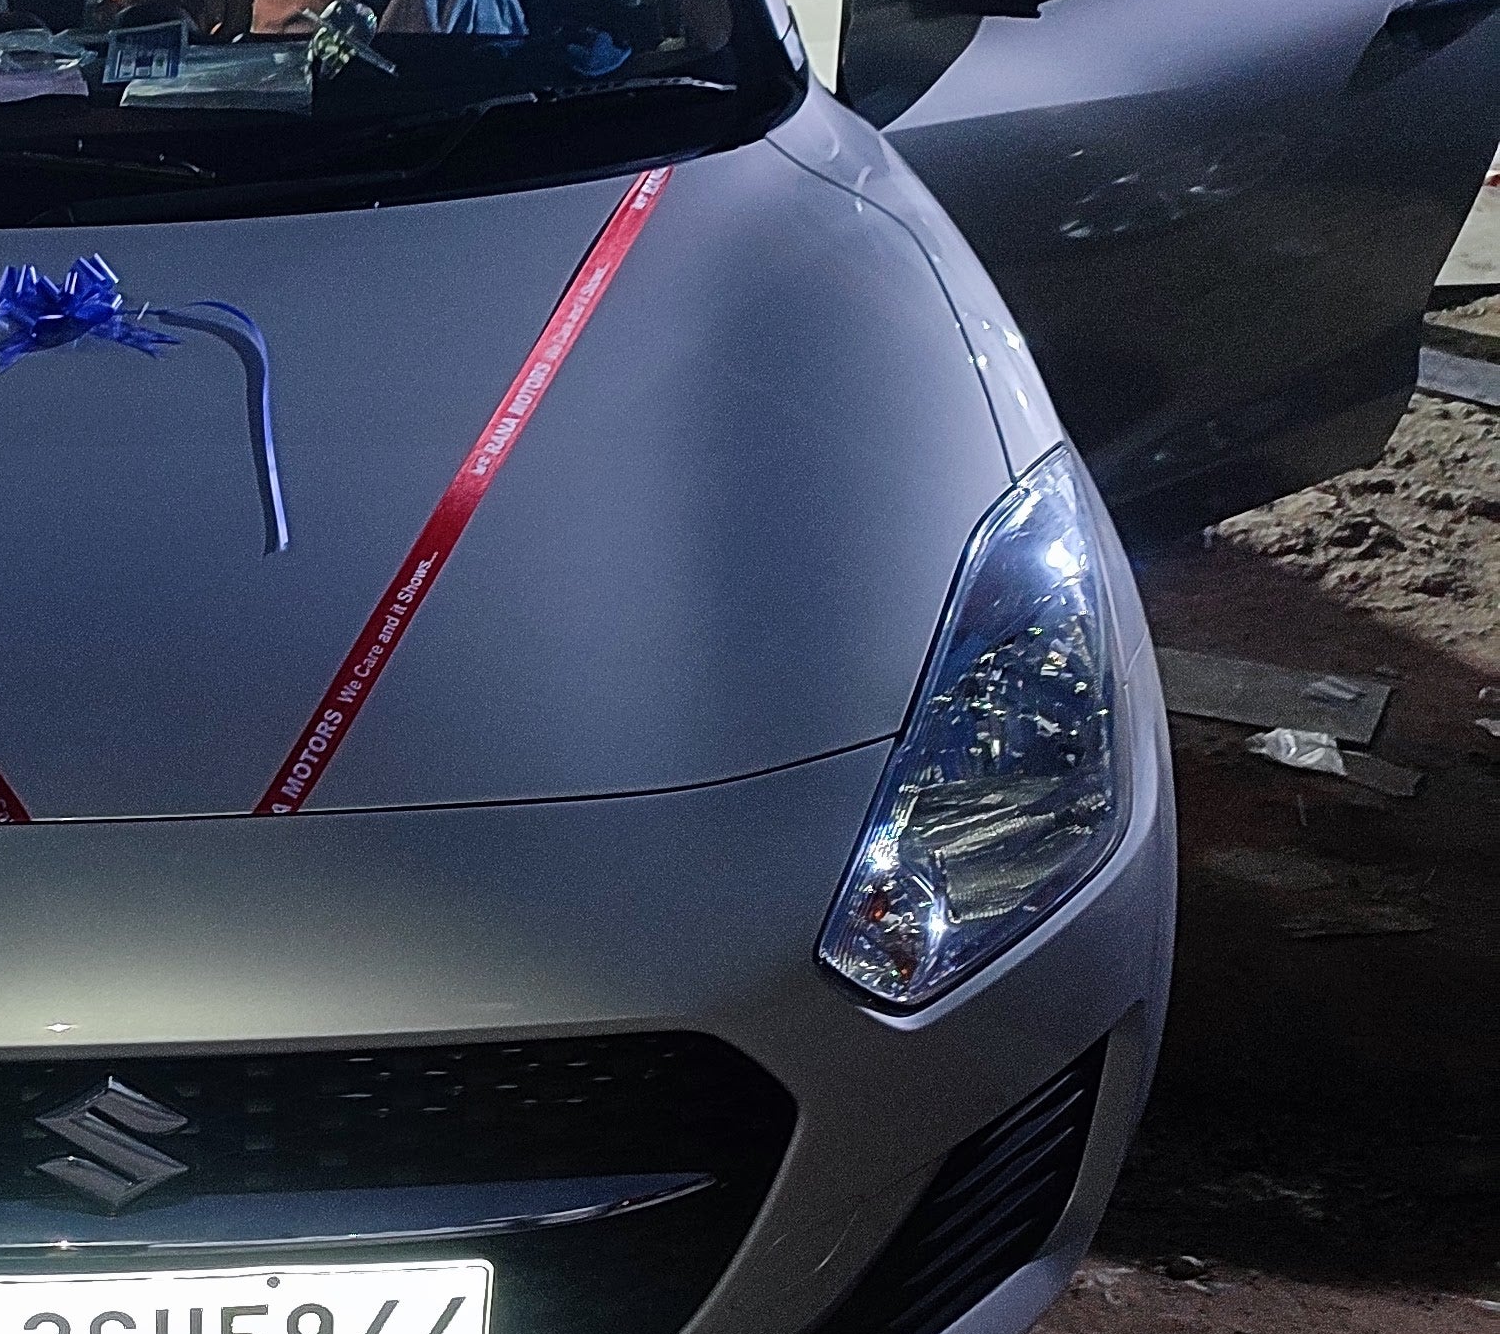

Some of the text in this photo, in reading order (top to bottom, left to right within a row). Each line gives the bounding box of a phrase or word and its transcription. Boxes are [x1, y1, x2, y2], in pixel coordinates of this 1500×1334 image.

[484, 417, 520, 456] RANA
[508, 362, 551, 416] MOTORS
[281, 708, 343, 798] MOTORS
[337, 678, 362, 704] We
[354, 644, 384, 678] Care
[378, 614, 401, 644] and
[390, 602, 408, 616] it
